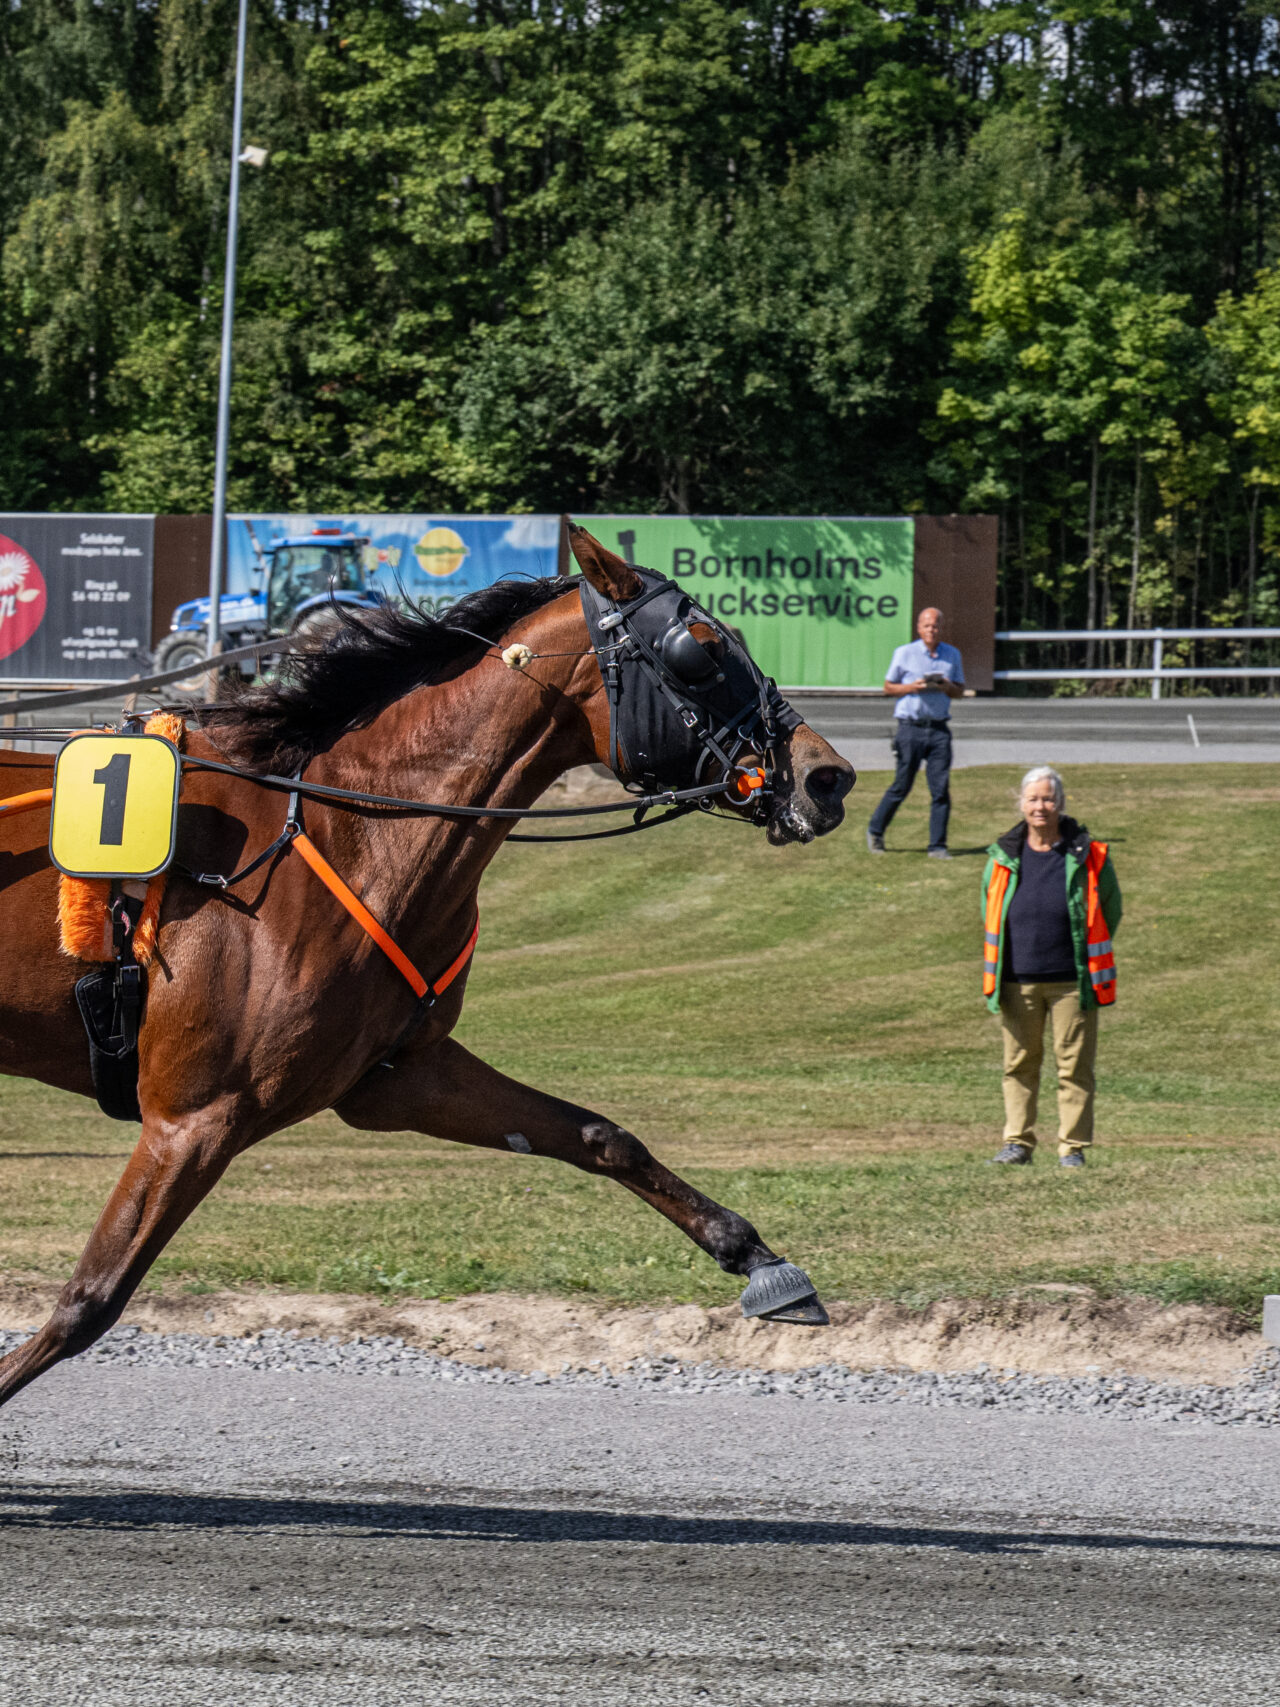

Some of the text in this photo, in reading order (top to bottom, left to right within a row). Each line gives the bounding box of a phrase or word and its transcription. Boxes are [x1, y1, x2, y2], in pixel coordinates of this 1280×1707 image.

[673, 548, 882, 579] Bornholms
[692, 586, 899, 618] uckservice
[93, 753, 141, 846] 1
